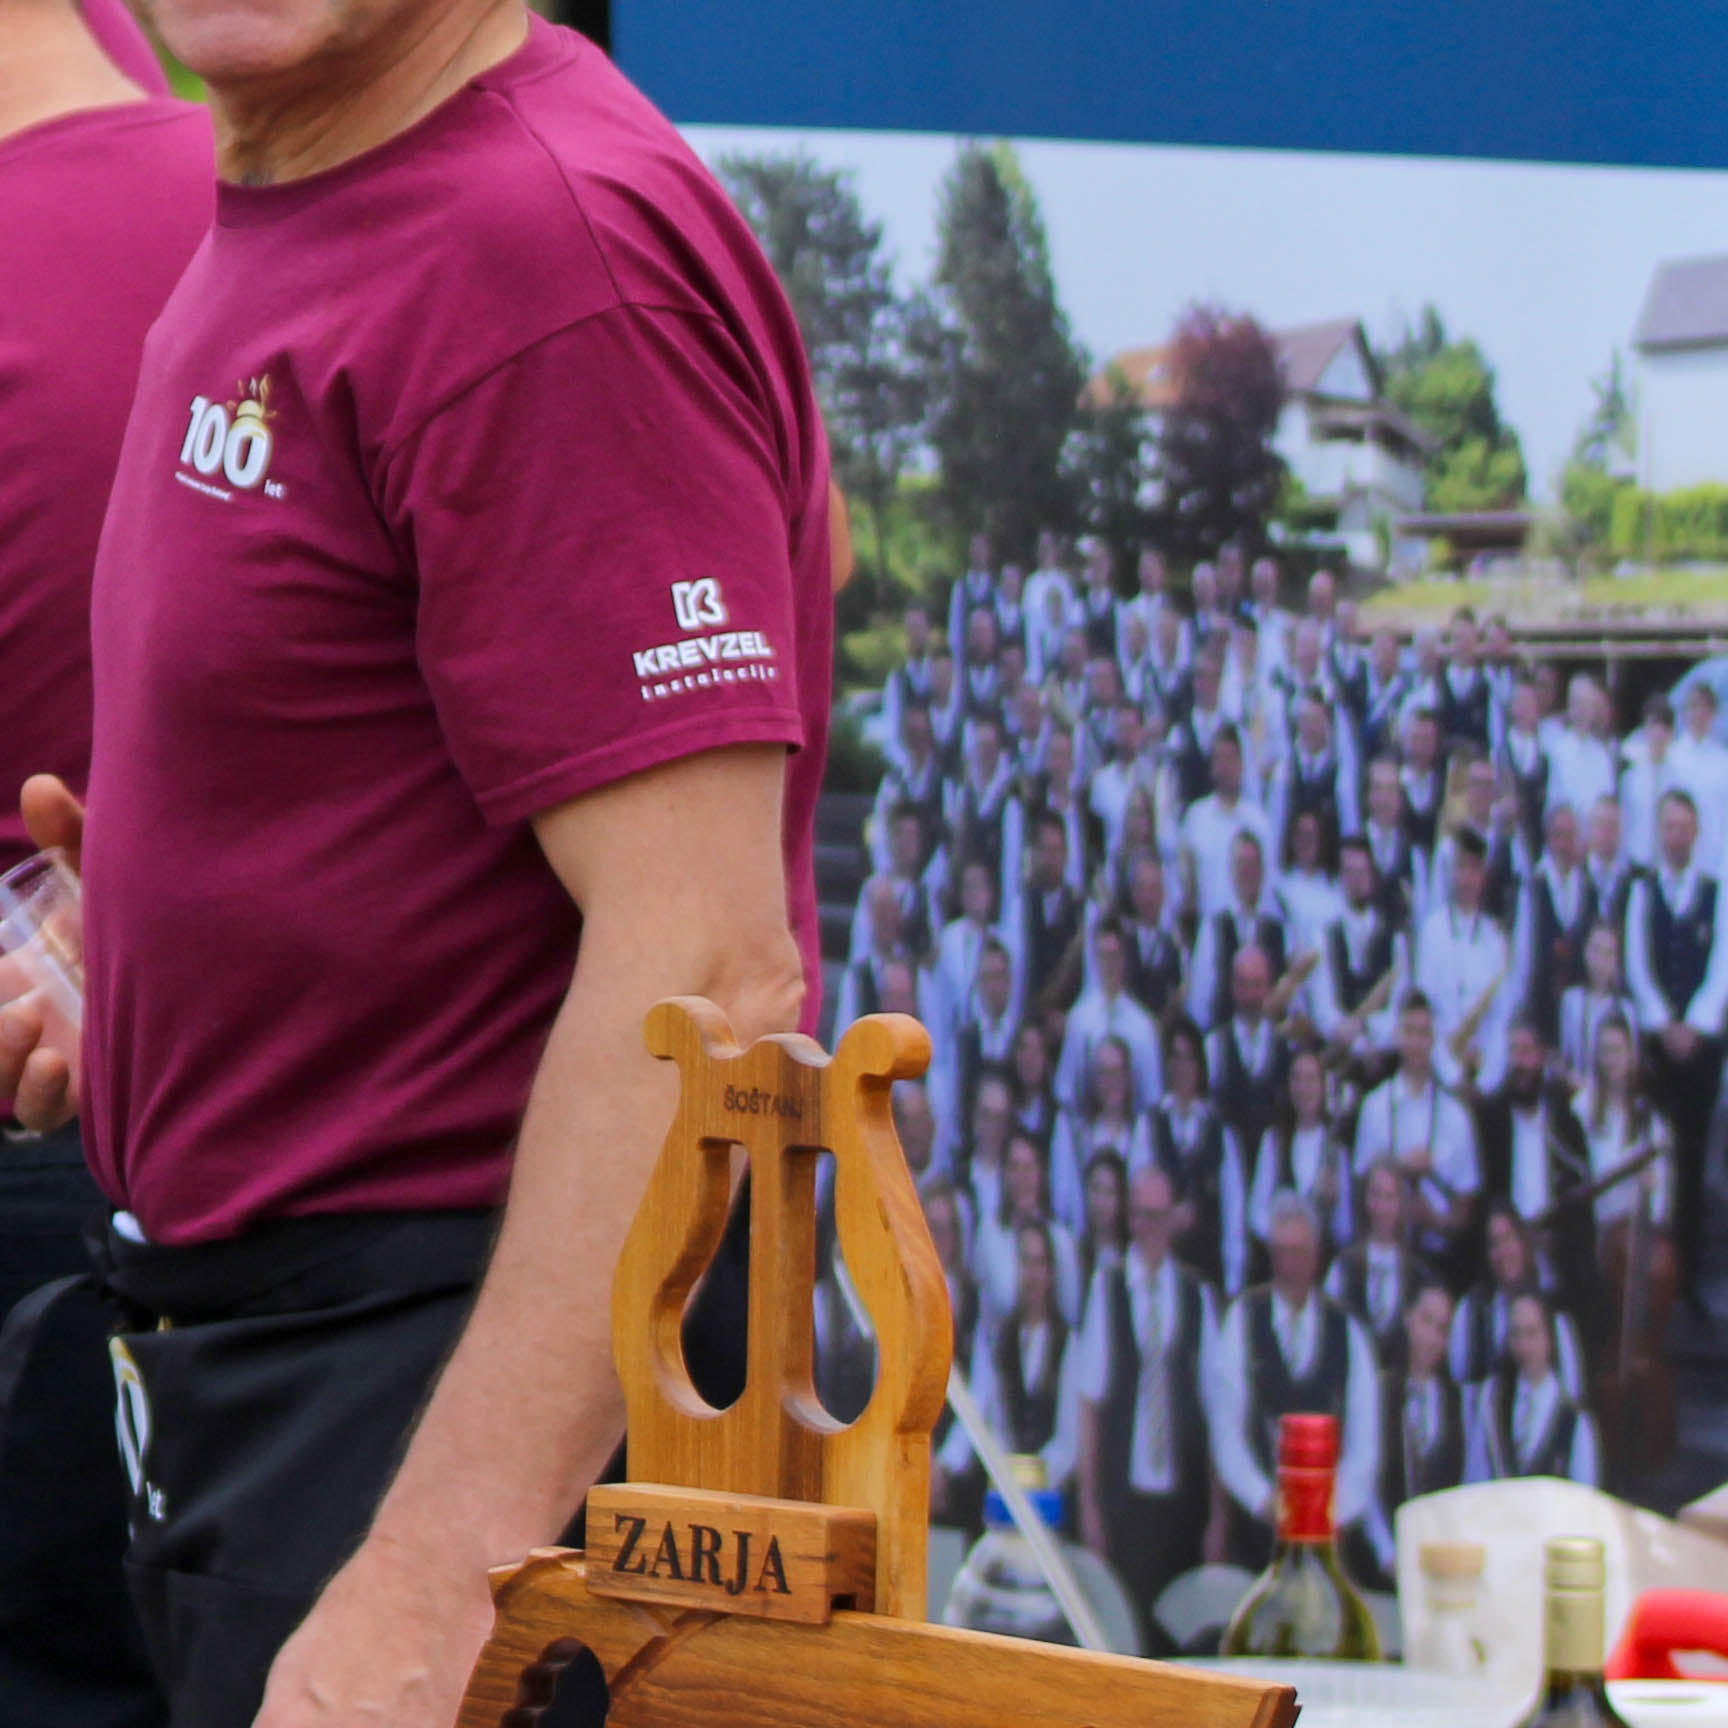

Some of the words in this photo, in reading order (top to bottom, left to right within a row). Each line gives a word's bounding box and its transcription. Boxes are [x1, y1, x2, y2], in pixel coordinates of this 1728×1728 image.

[180, 395, 274, 489] 100
[632, 631, 775, 679] KREVZEL
[612, 1513, 793, 1596] ZARJA
